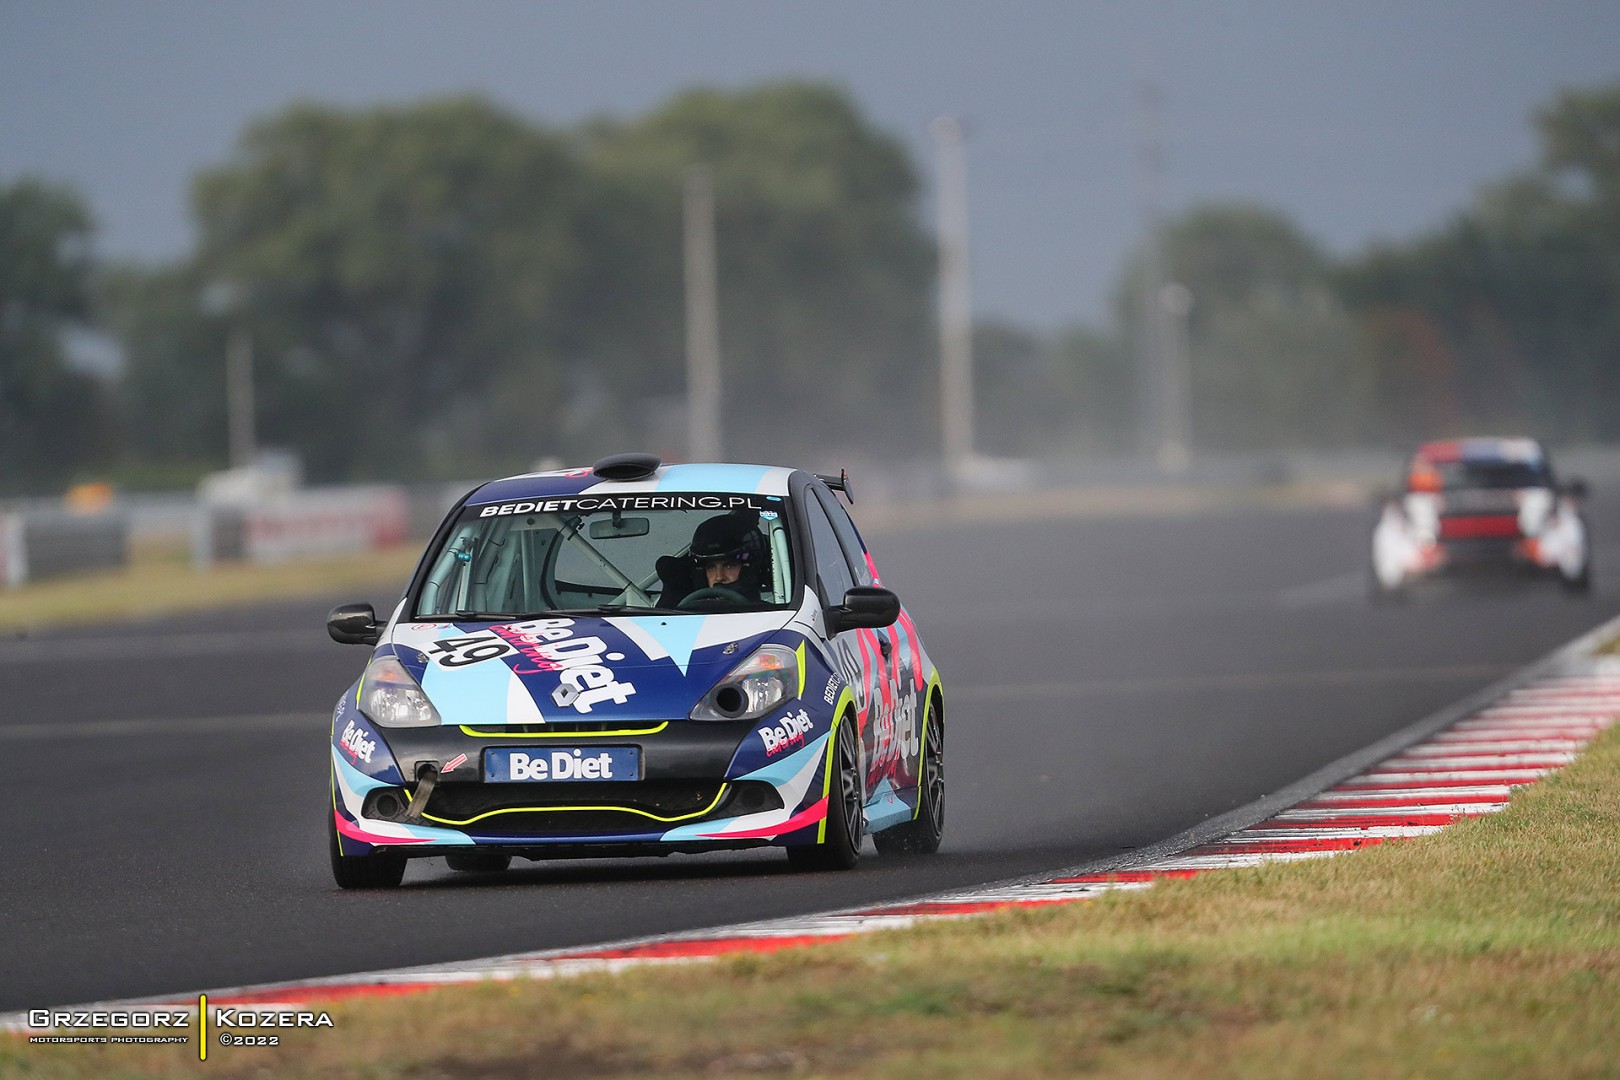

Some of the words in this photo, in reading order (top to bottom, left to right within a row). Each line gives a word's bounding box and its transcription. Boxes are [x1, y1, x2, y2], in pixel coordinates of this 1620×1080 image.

[480, 496, 762, 517] BEDIETCATERING.PL
[511, 618, 575, 646] Be
[428, 636, 511, 668] 49
[533, 635, 637, 714] Diet
[341, 719, 355, 747] Be
[349, 728, 376, 764] Diet
[757, 726, 788, 752] Be
[779, 708, 814, 741] Diet
[509, 753, 548, 780] Be
[551, 748, 613, 780] Diet
